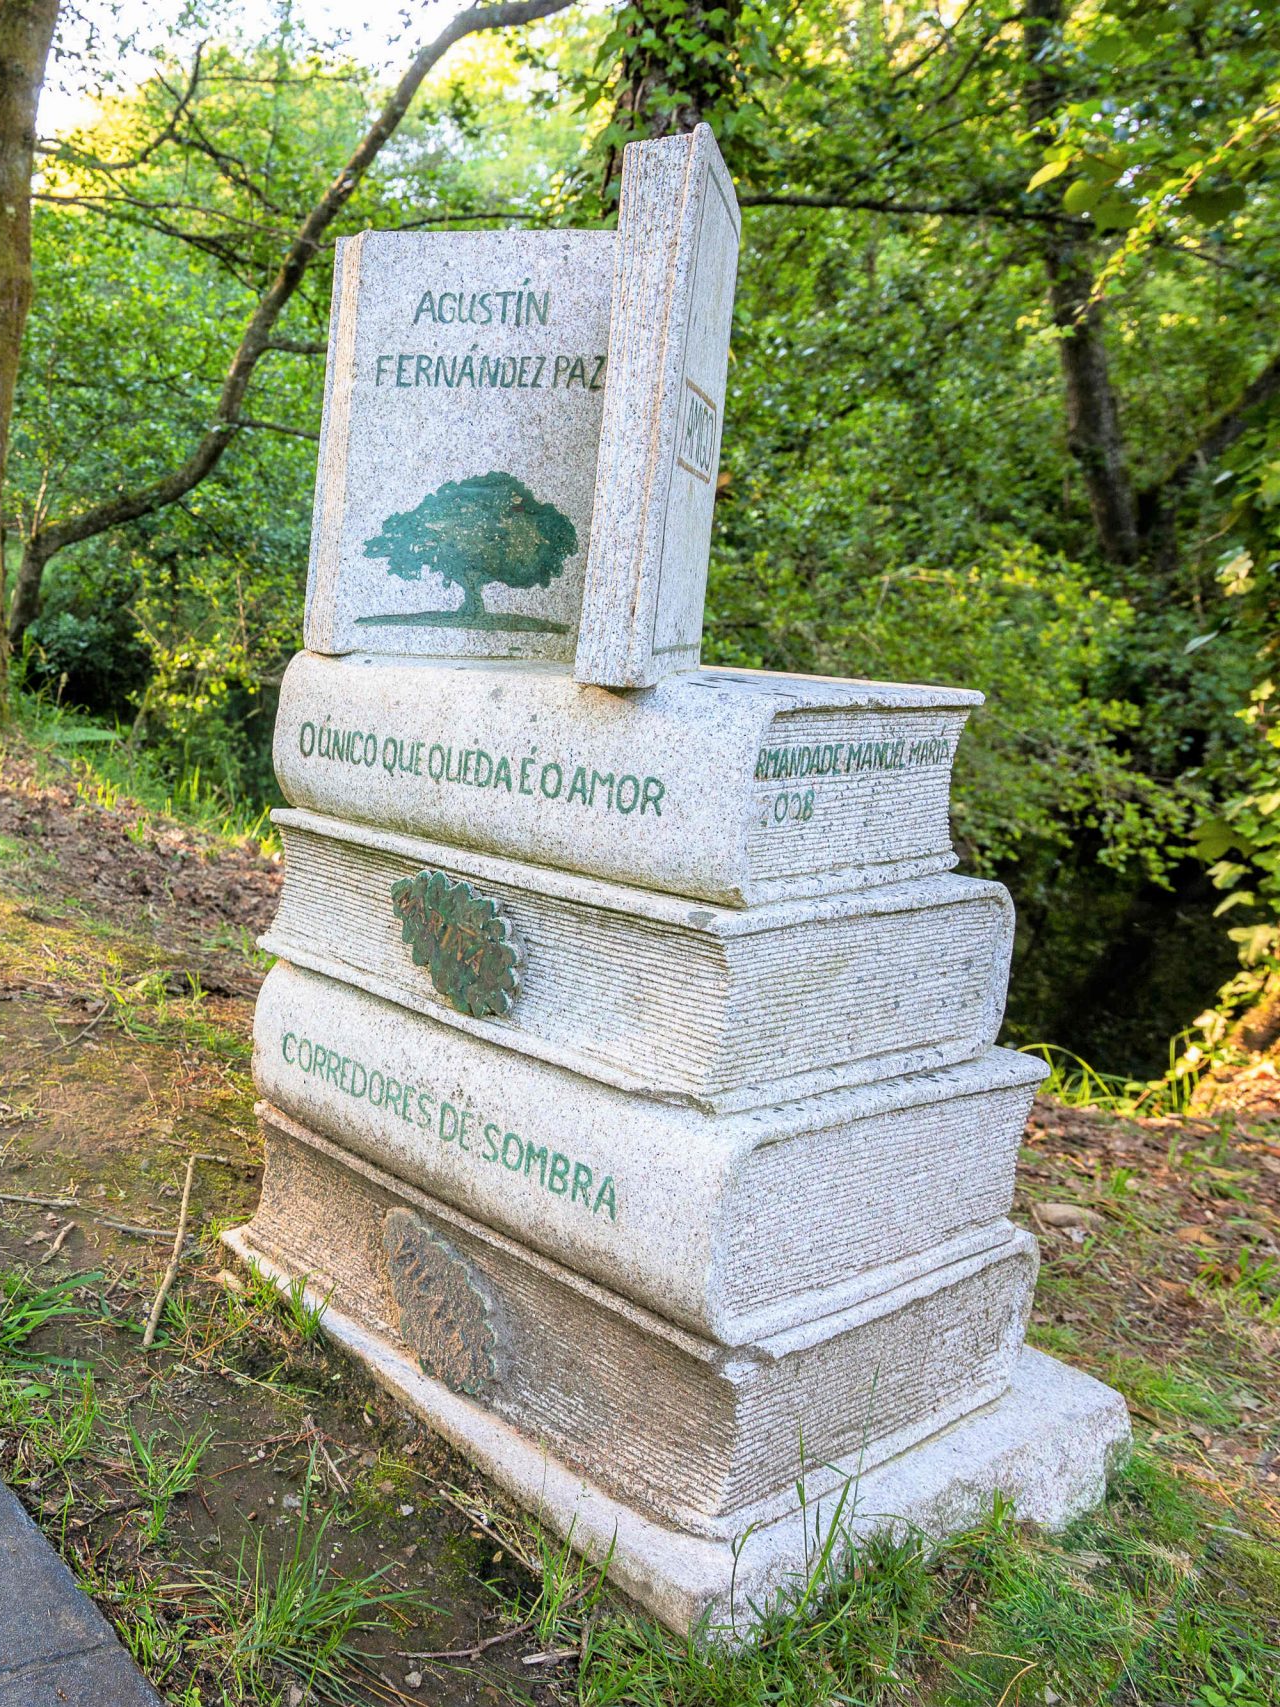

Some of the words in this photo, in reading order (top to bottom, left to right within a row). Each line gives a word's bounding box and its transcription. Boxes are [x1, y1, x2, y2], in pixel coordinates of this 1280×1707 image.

[413, 278, 551, 326] AGUSTÍN
[375, 344, 543, 389] FERNÁNDEZ
[553, 355, 607, 389] PAZ
[299, 721, 315, 757] O
[318, 714, 378, 768] ÚNICO
[382, 737, 425, 777] QUE
[428, 743, 512, 792] QUEDA
[518, 746, 538, 795] É
[540, 762, 563, 799] O
[567, 766, 666, 817] AMOR
[282, 1031, 433, 1129] CORREDORES
[439, 1101, 474, 1151] DE
[482, 1122, 617, 1222] SOMBRA
